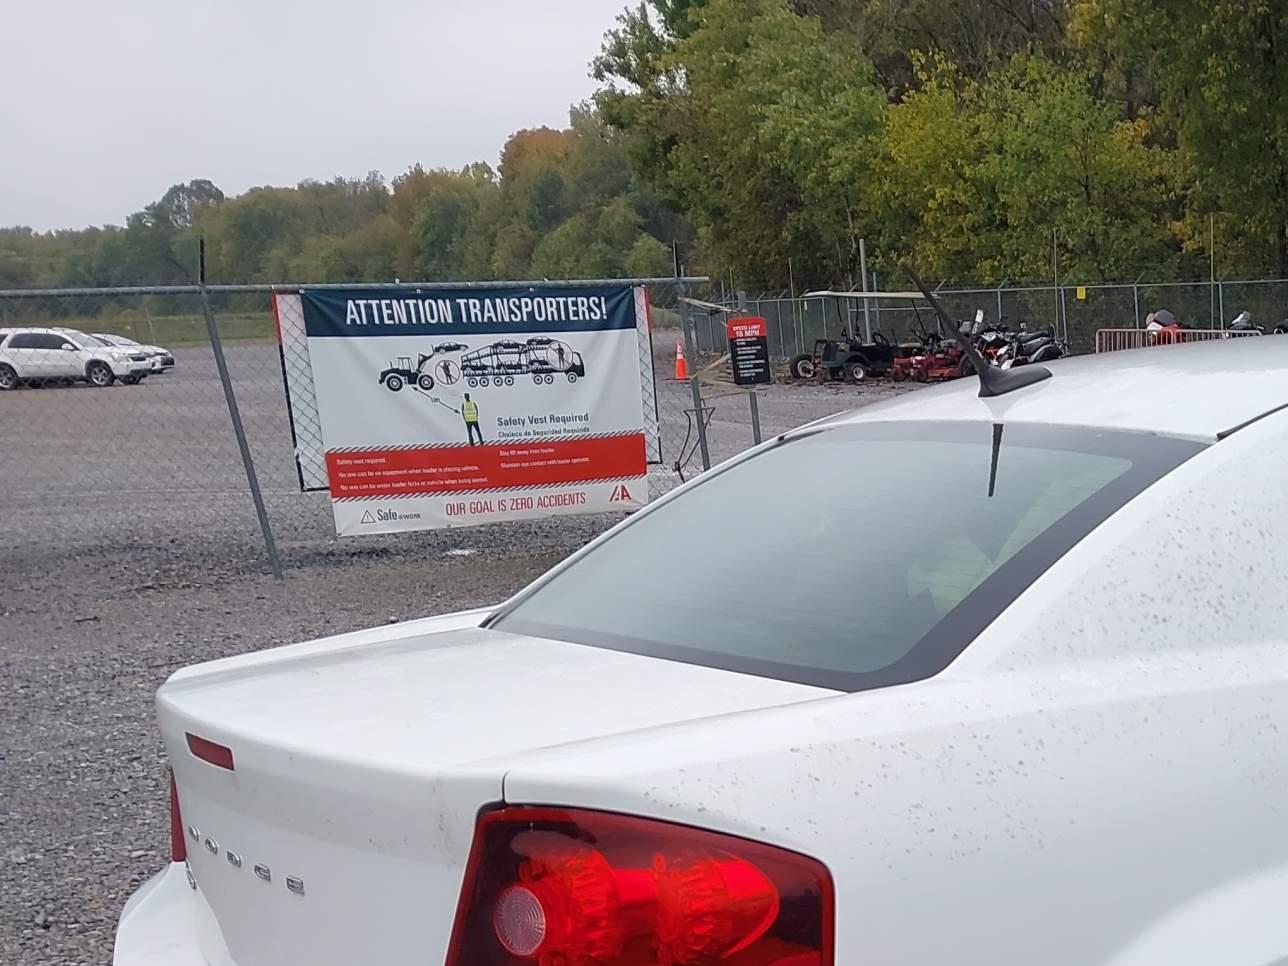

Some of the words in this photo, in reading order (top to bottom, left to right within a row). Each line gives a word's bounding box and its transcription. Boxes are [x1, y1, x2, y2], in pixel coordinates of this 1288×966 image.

[346, 299, 453, 325] ATTENTION
[456, 296, 608, 322] TRANSPORTERS!
[497, 417, 526, 428] Safety
[527, 415, 547, 425] Vest
[549, 412, 589, 425] Required
[445, 502, 467, 516] OUR
[469, 500, 494, 514] GOAL
[497, 498, 507, 512] IS
[510, 496, 534, 511] ZERO
[536, 491, 586, 509] ACCIDENTS
[376, 508, 398, 522] Safe
